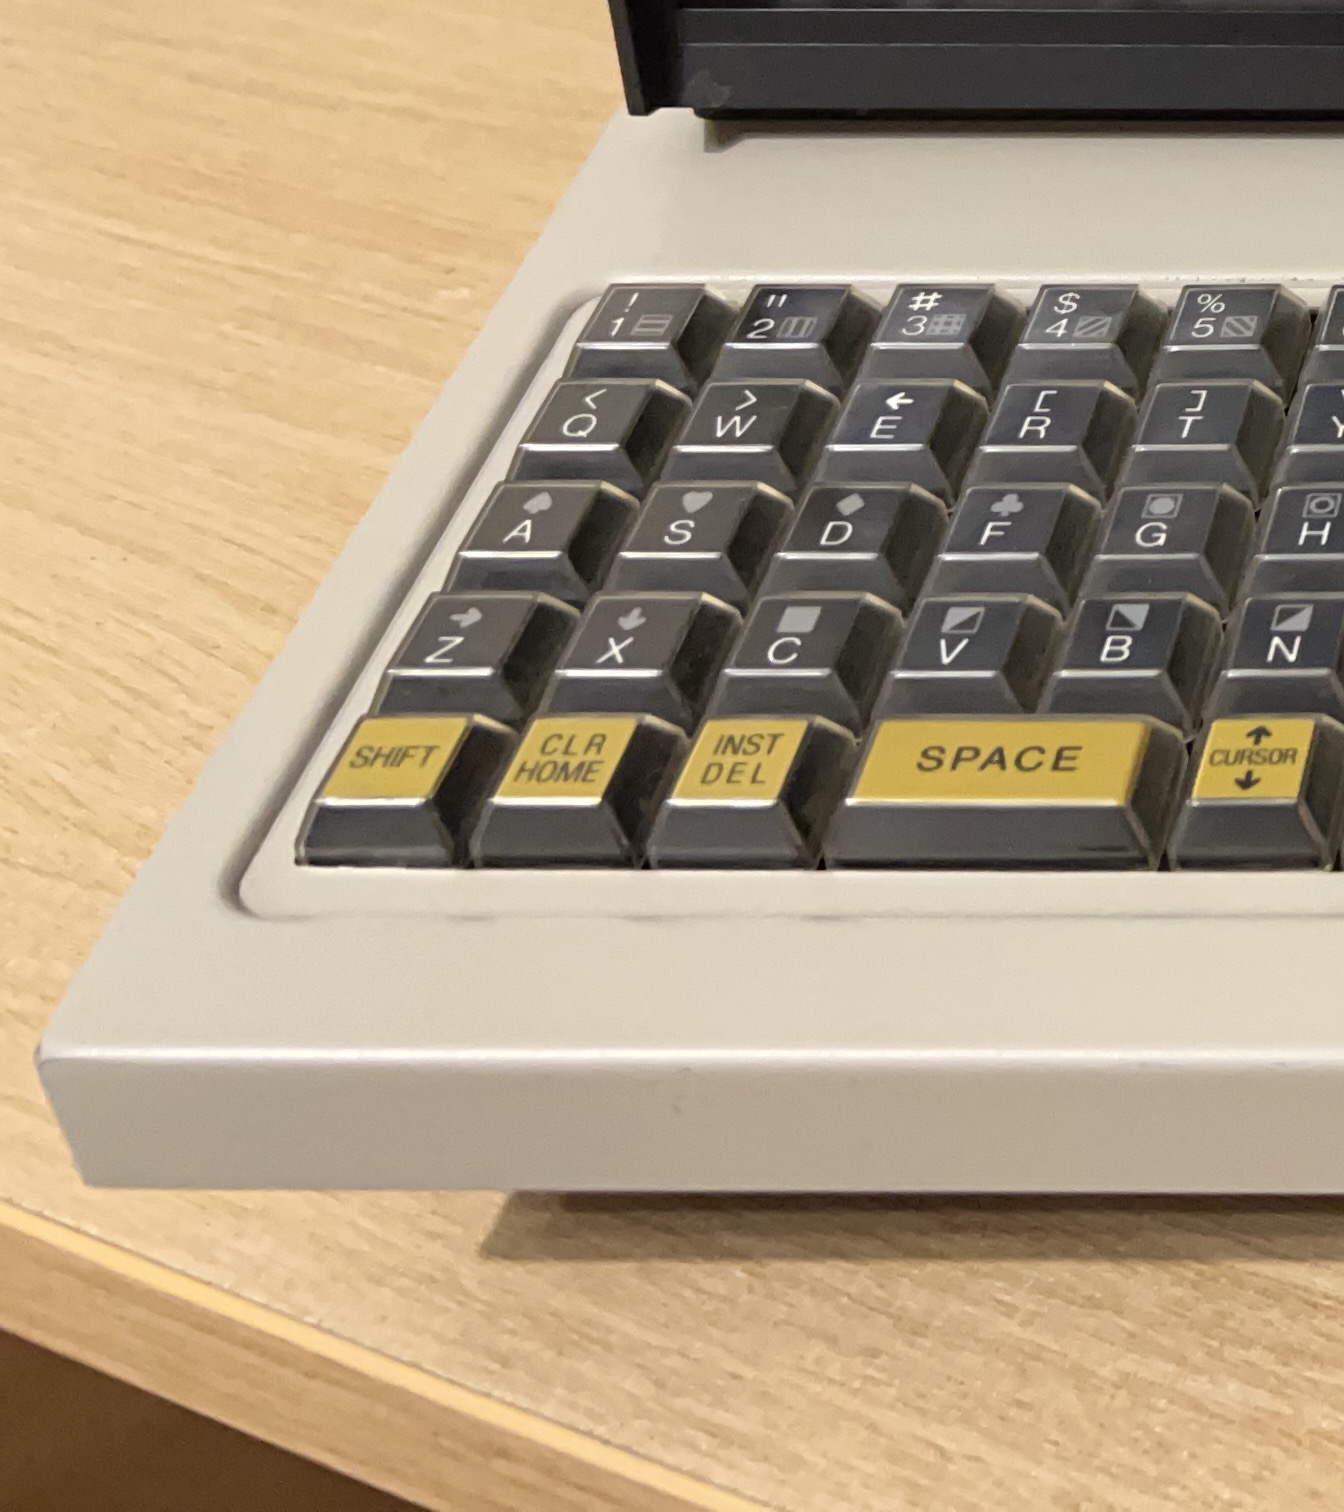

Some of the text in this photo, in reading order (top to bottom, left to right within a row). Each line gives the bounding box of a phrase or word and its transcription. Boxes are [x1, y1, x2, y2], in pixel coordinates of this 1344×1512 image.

[608, 318, 623, 336] 1
[747, 319, 774, 339] 2
[902, 316, 926, 335] 3
[1045, 318, 1069, 336] 4
[1191, 318, 1215, 337] 5
[562, 415, 597, 438] Q
[715, 415, 757, 438] W
[870, 416, 901, 438] E
[1018, 416, 1051, 439] R
[1178, 416, 1204, 438] T
[503, 520, 534, 543] A
[664, 520, 695, 545] S
[820, 522, 853, 545] D
[978, 522, 1013, 546] F
[1135, 523, 1167, 547] G
[1298, 522, 1331, 545] H
[424, 636, 465, 663] Z
[596, 637, 635, 664] X
[767, 637, 801, 664] C
[938, 639, 969, 665] V
[1100, 636, 1131, 662] B
[1266, 636, 1301, 662] N
[540, 733, 607, 756] CLR
[713, 733, 785, 755] INST
[349, 745, 441, 768] SHIFT
[917, 746, 1083, 772] SPACE
[1209, 748, 1298, 767] CURSOR
[513, 760, 604, 783] HOME
[701, 761, 765, 784] DEL
